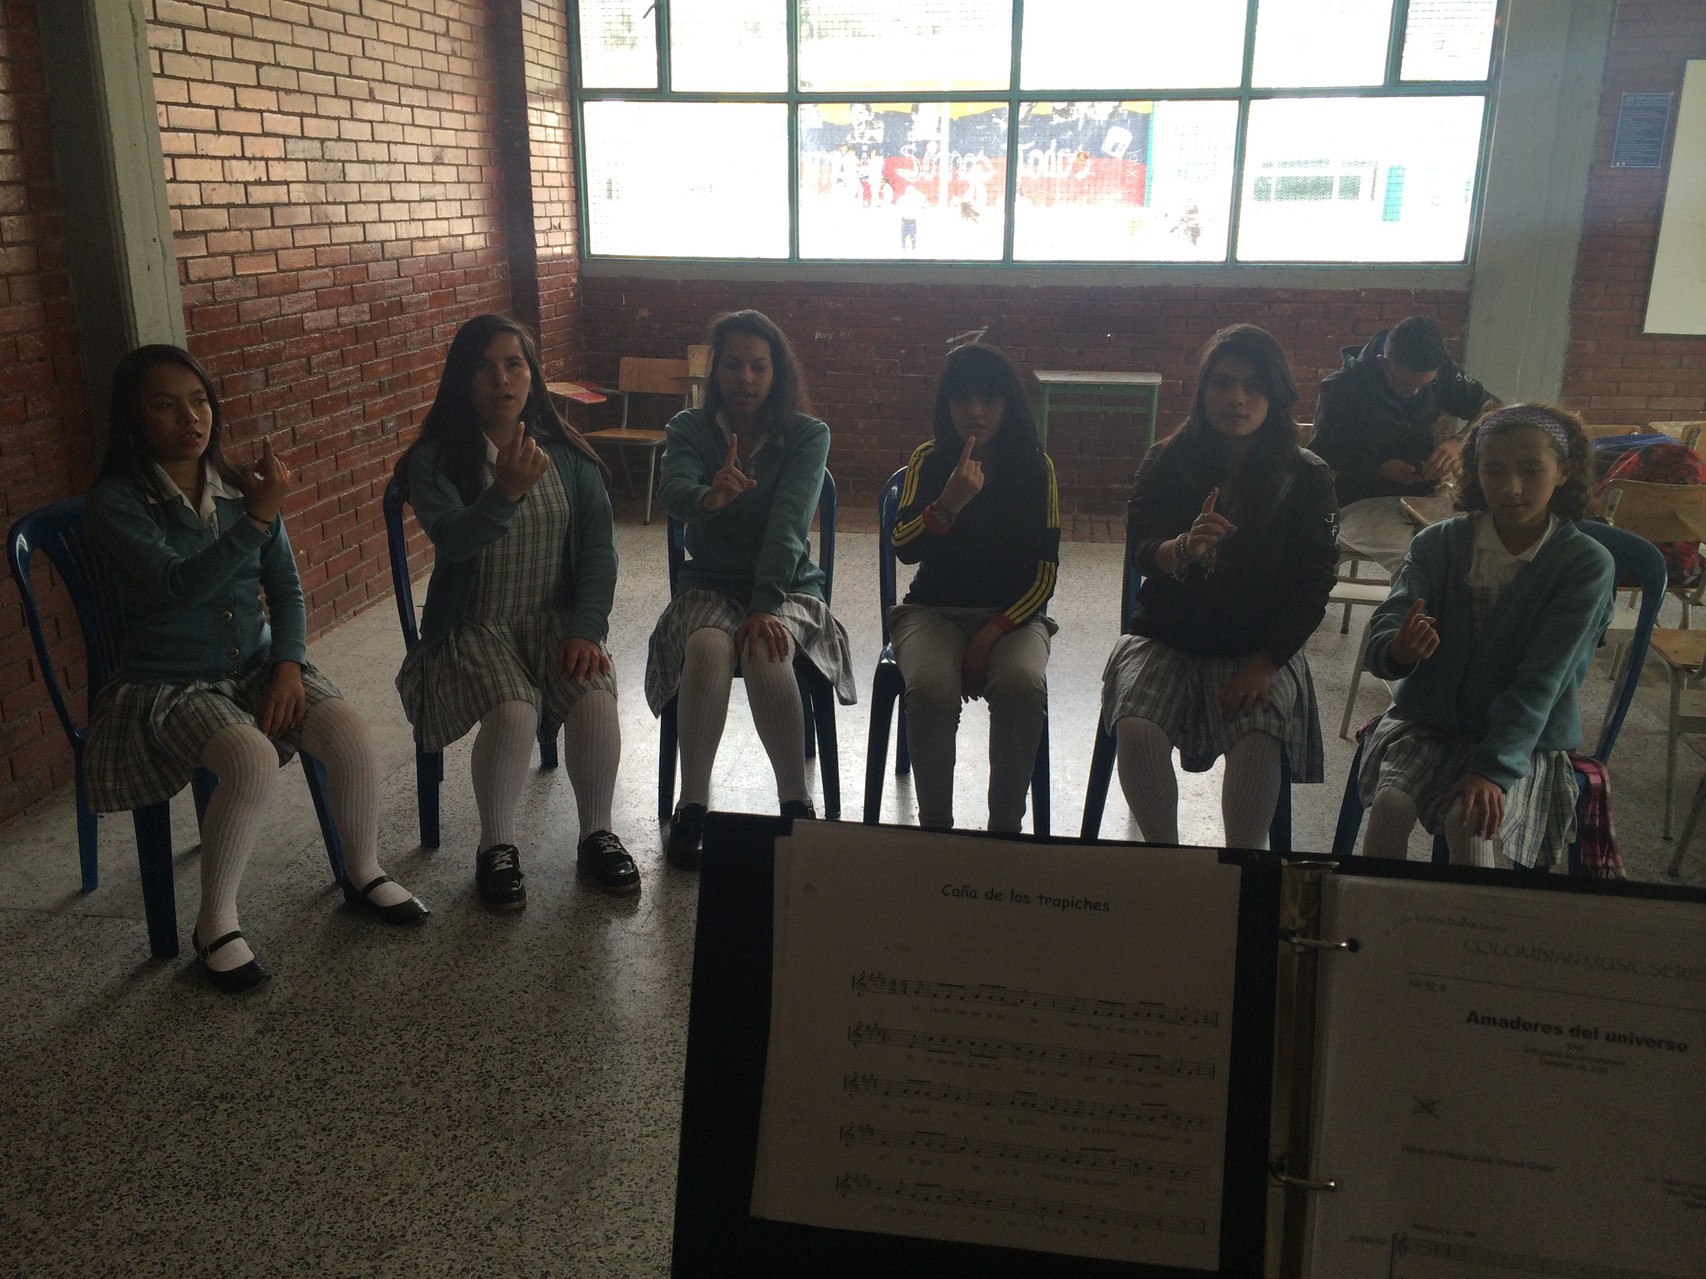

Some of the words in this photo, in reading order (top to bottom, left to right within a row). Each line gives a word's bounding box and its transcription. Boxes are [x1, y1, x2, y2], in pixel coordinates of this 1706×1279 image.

[941, 883, 978, 900] Caña
[984, 887, 1003, 901] de
[1010, 886, 1031, 905] los
[1038, 893, 1111, 912] trapiches
[1463, 938, 1581, 967] COLOMBIAN
[1583, 954, 1648, 977] MUSIC
[1650, 961, 1706, 982] SERIE
[1465, 1010, 1564, 1036] Amadores
[1568, 1023, 1600, 1041] del
[1604, 1030, 1690, 1054] universo
